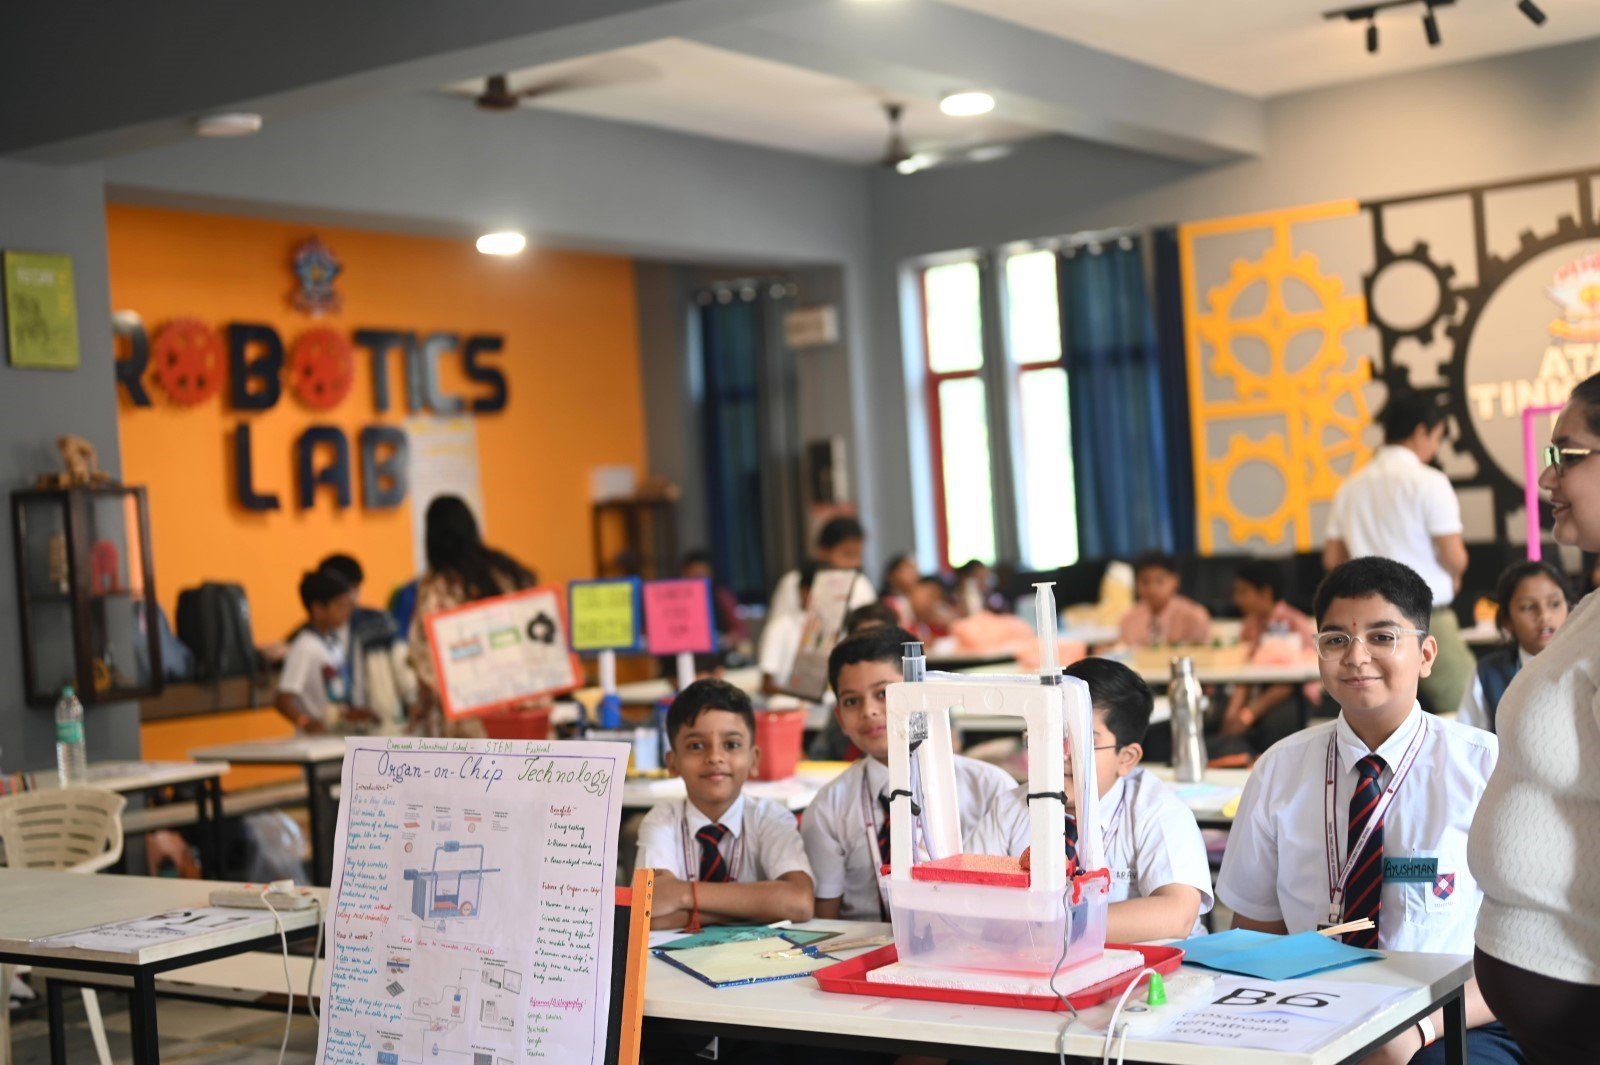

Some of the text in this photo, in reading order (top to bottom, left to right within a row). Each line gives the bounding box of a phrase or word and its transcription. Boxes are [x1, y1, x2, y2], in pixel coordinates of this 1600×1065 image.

[111, 309, 509, 416] ROBOTICS
[236, 421, 408, 511] LAB
[485, 742, 512, 753] STEM
[518, 756, 610, 796] Technology
[1385, 861, 1435, 877] AYUSHMAN
[1211, 988, 1341, 1008] B6
[1174, 1020, 1290, 1033] ternational
